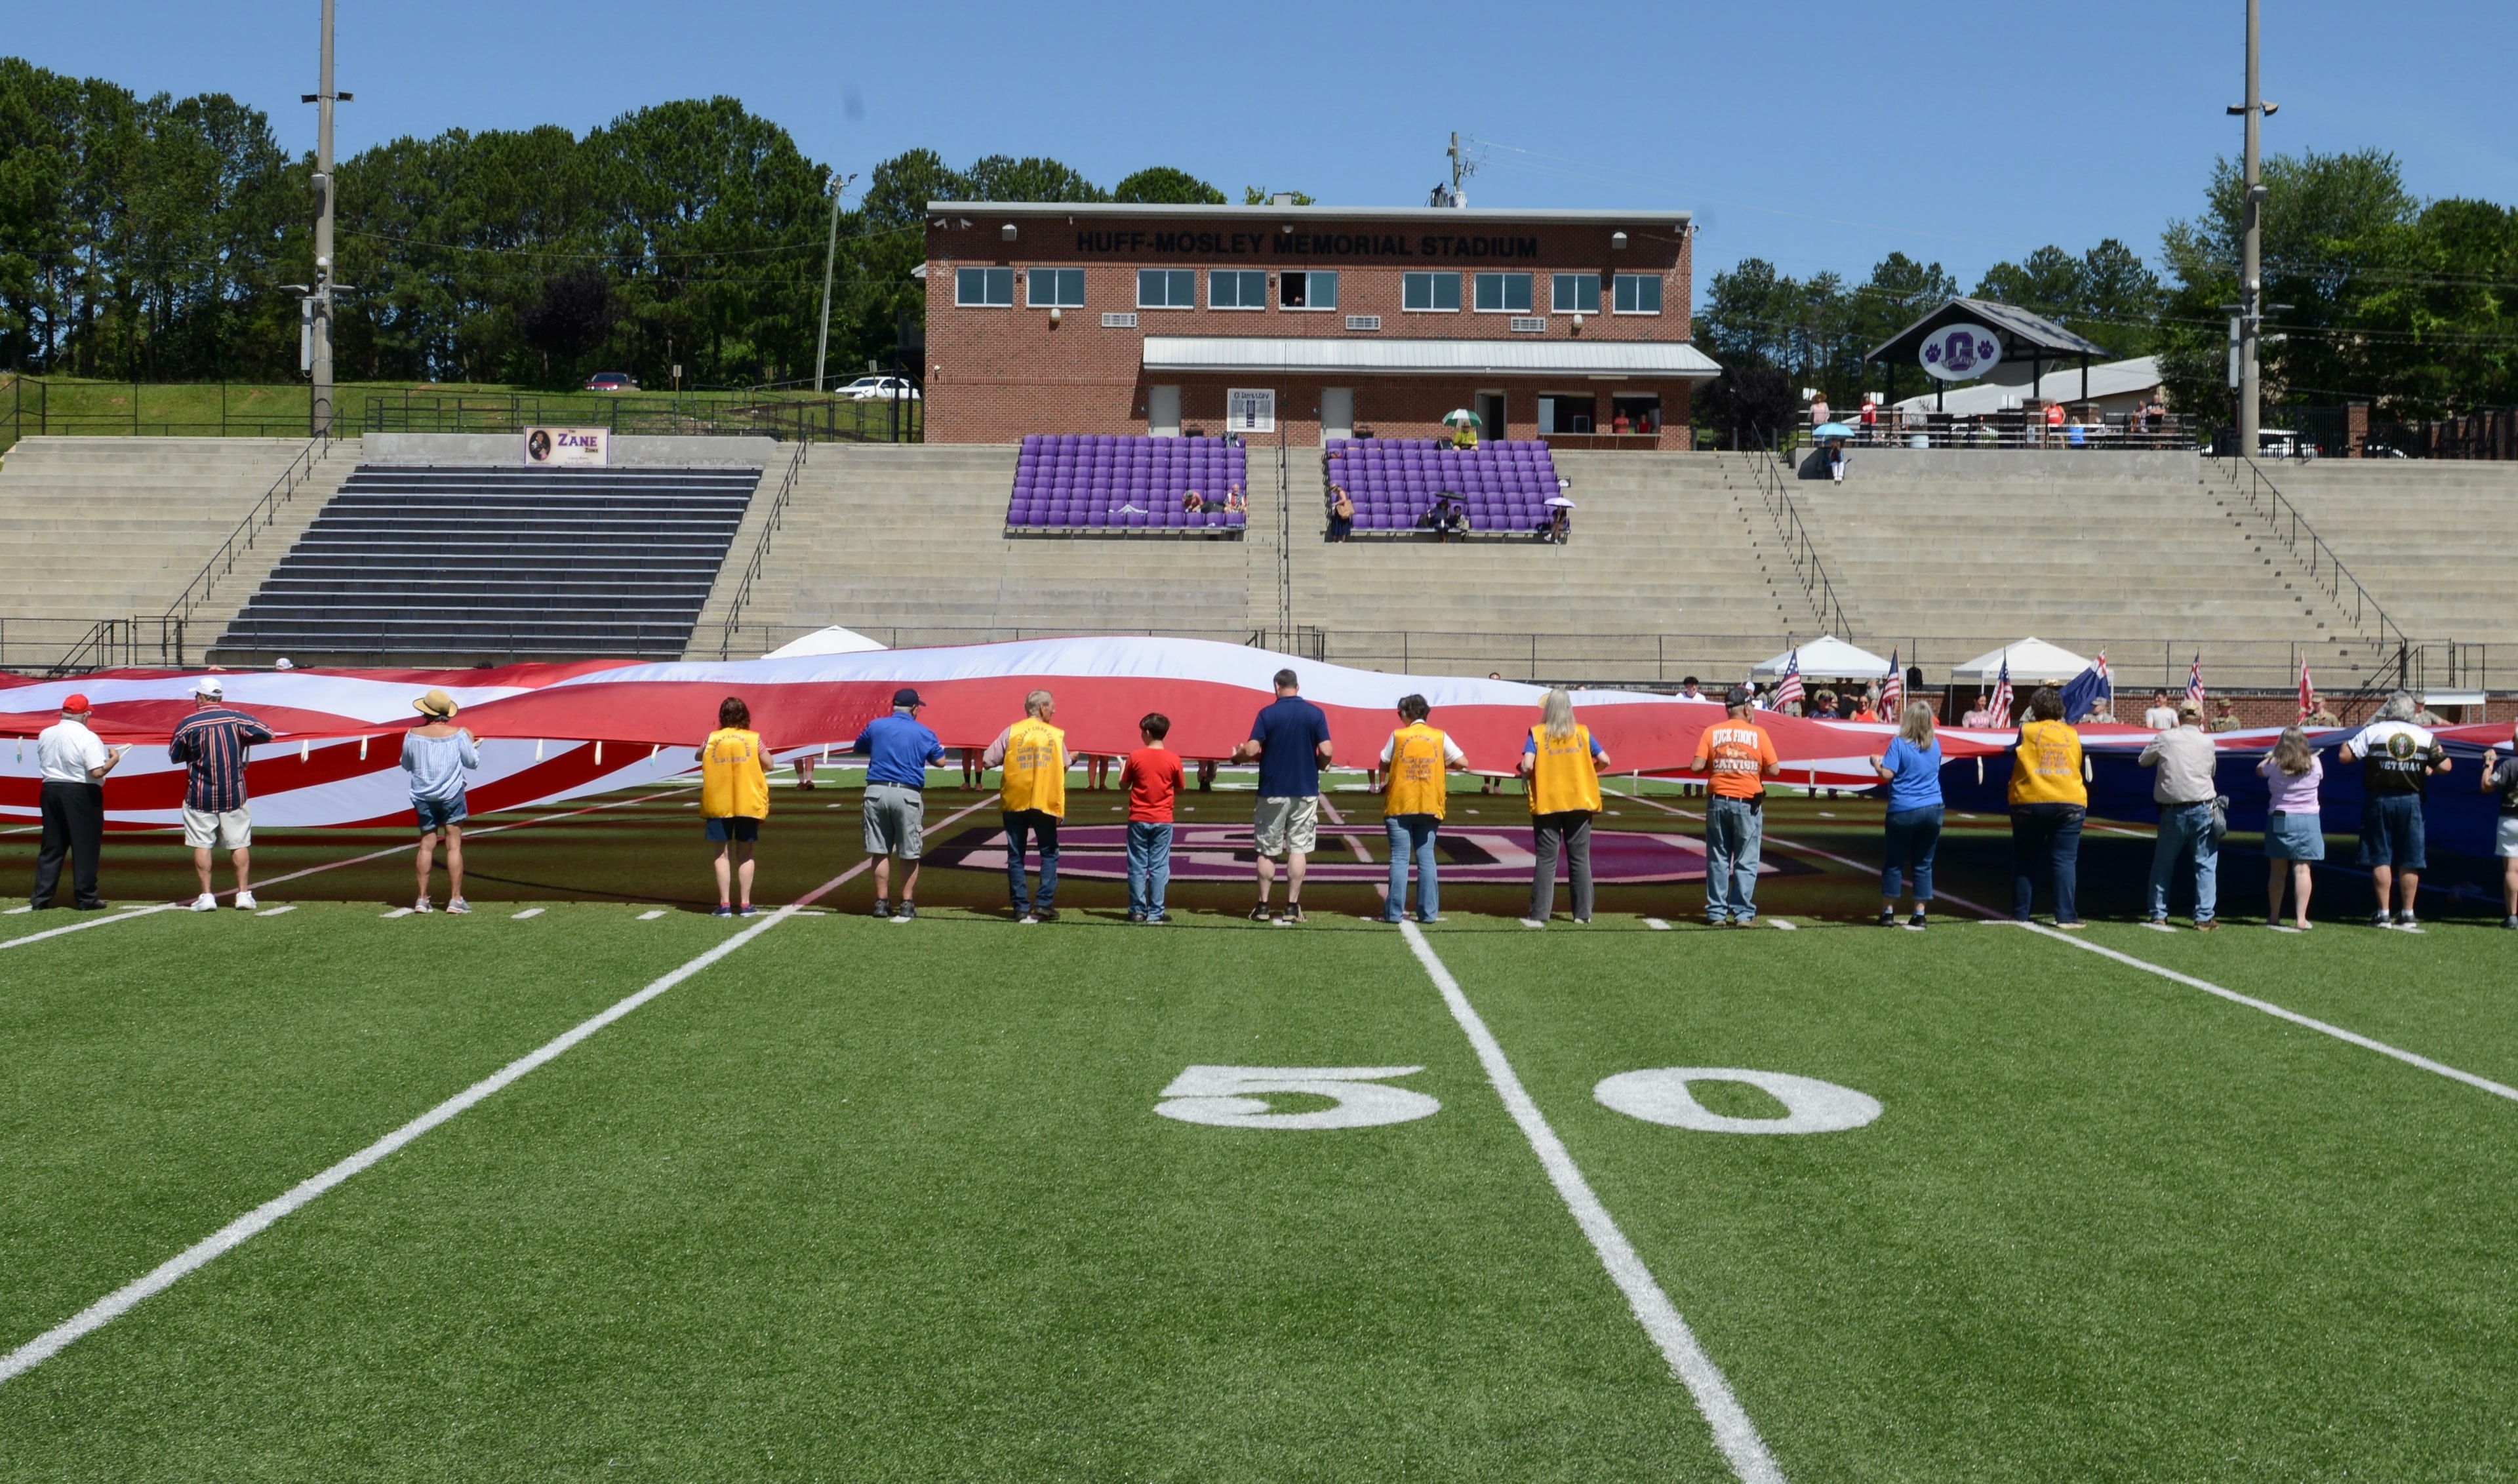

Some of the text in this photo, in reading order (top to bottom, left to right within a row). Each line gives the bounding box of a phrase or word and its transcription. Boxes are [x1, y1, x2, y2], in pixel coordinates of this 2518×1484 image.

[1077, 231, 1538, 258] HUFF-MOSLEY MEMORIAL STADIUM
[558, 433, 597, 447] ZANE
[2378, 760, 2421, 772] VETERAN
